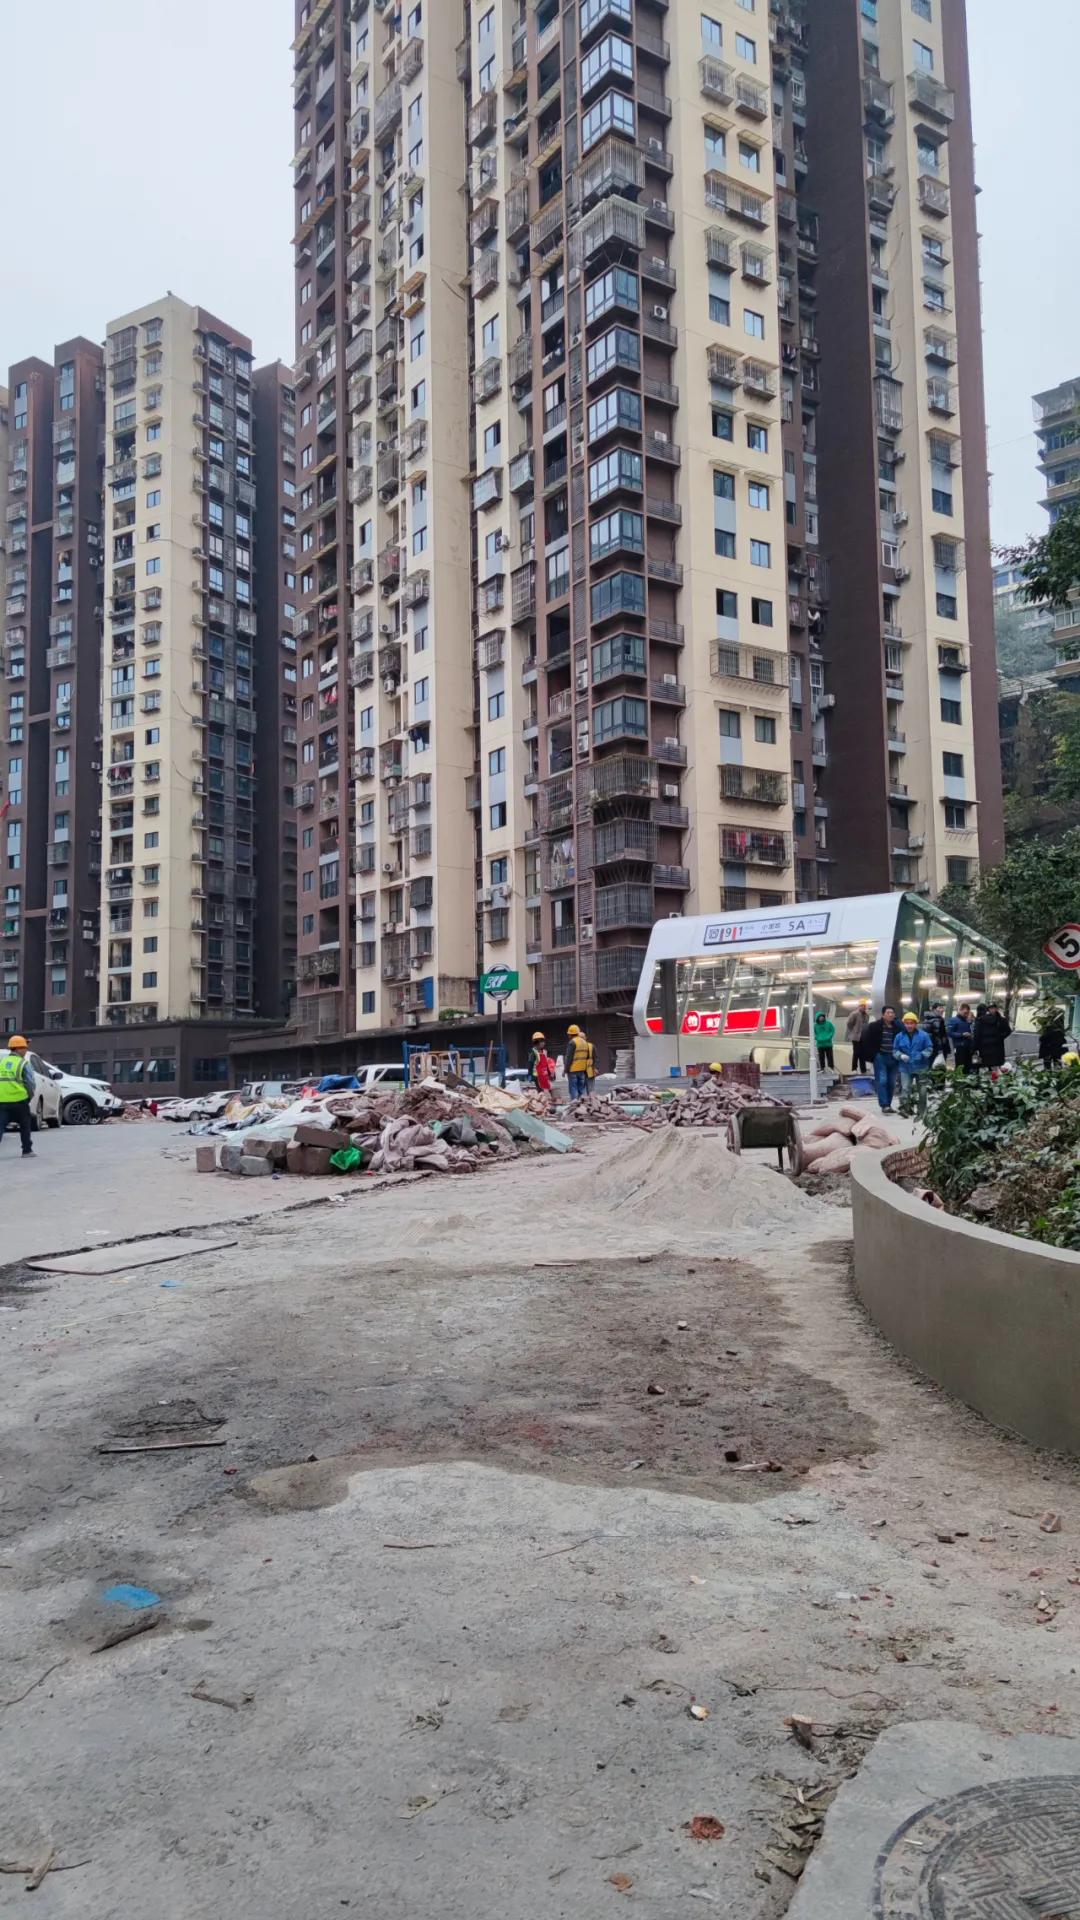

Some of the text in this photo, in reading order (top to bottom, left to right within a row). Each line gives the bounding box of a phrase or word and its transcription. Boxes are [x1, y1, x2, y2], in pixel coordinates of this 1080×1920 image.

[725, 927, 732, 938] 9
[788, 920, 805, 931] 5A
[1054, 932, 1080, 957] 5
